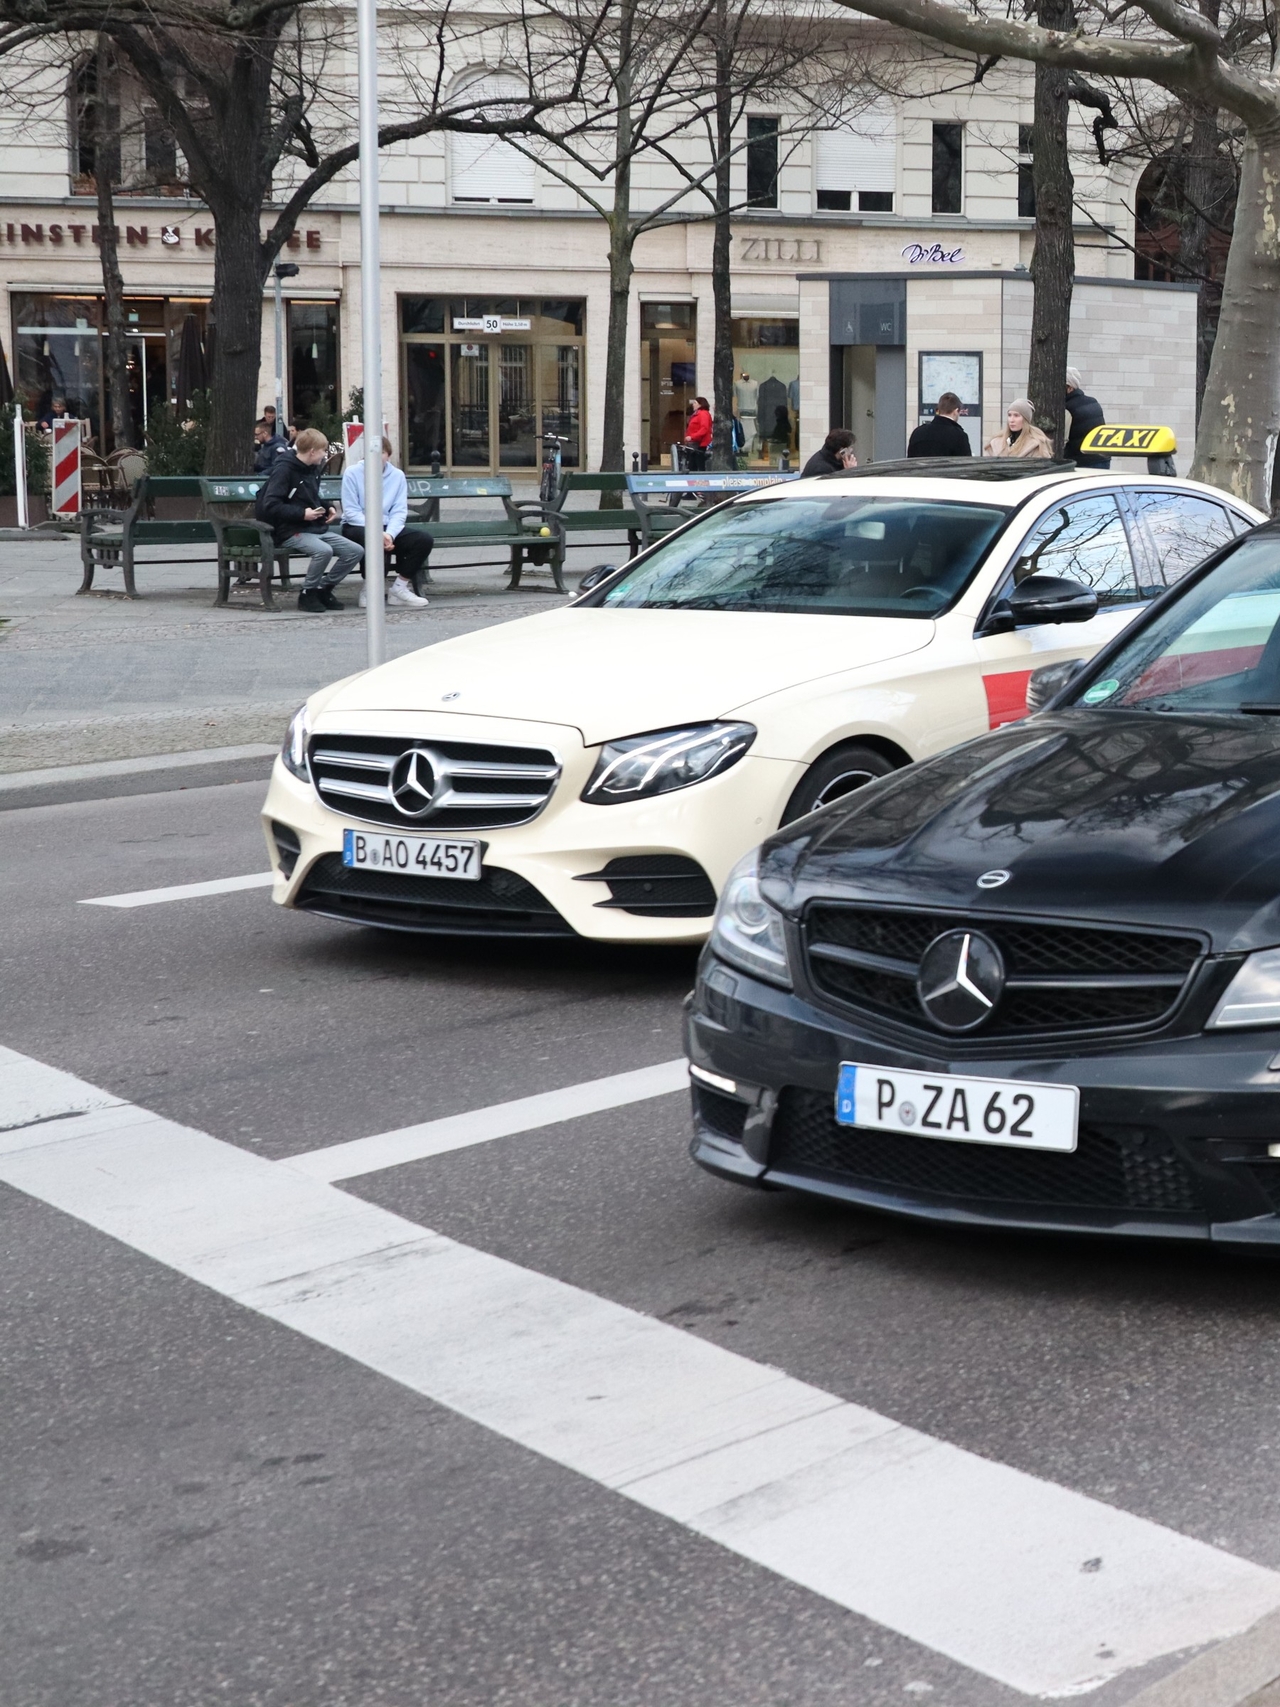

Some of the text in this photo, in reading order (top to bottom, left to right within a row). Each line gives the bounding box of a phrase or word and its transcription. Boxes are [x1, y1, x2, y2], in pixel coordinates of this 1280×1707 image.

[741, 237, 824, 263] ZILLI
[486, 319, 498, 329] 50
[880, 322, 892, 332] WC
[1097, 429, 1156, 447] TAXI
[355, 835, 367, 863] B
[382, 839, 409, 869] AO
[415, 842, 475, 874] 4457
[842, 1078, 1035, 1138] D P ZA 62
